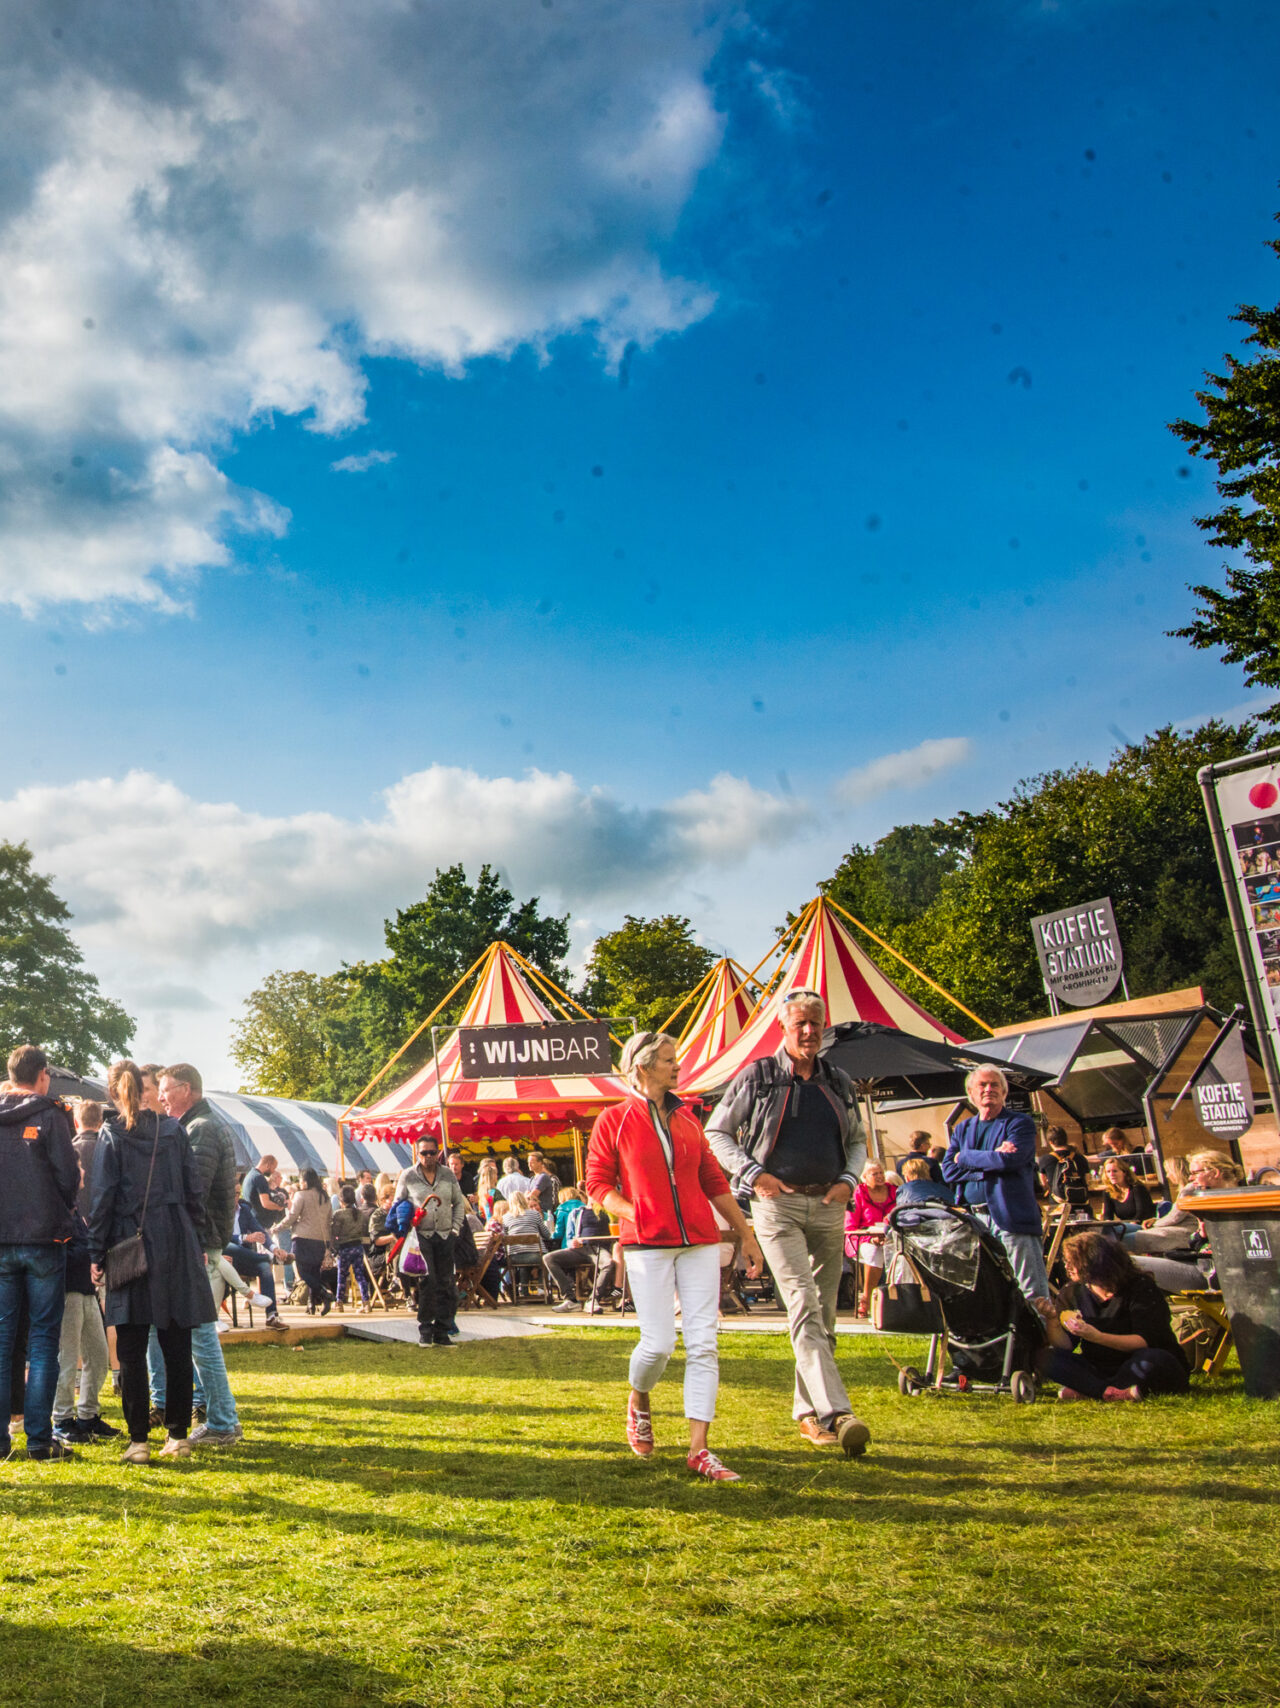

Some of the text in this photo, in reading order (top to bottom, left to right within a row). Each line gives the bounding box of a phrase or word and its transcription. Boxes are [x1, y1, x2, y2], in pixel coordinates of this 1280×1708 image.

[1039, 908, 1110, 948] KOFFIE
[1045, 938, 1116, 975] STATION
[1050, 963, 1117, 985] MICROBRANDERIJ
[482, 1036, 600, 1065] WIJNBAR
[1196, 1082, 1245, 1104] KOFFIE
[1201, 1101, 1248, 1121] STATION
